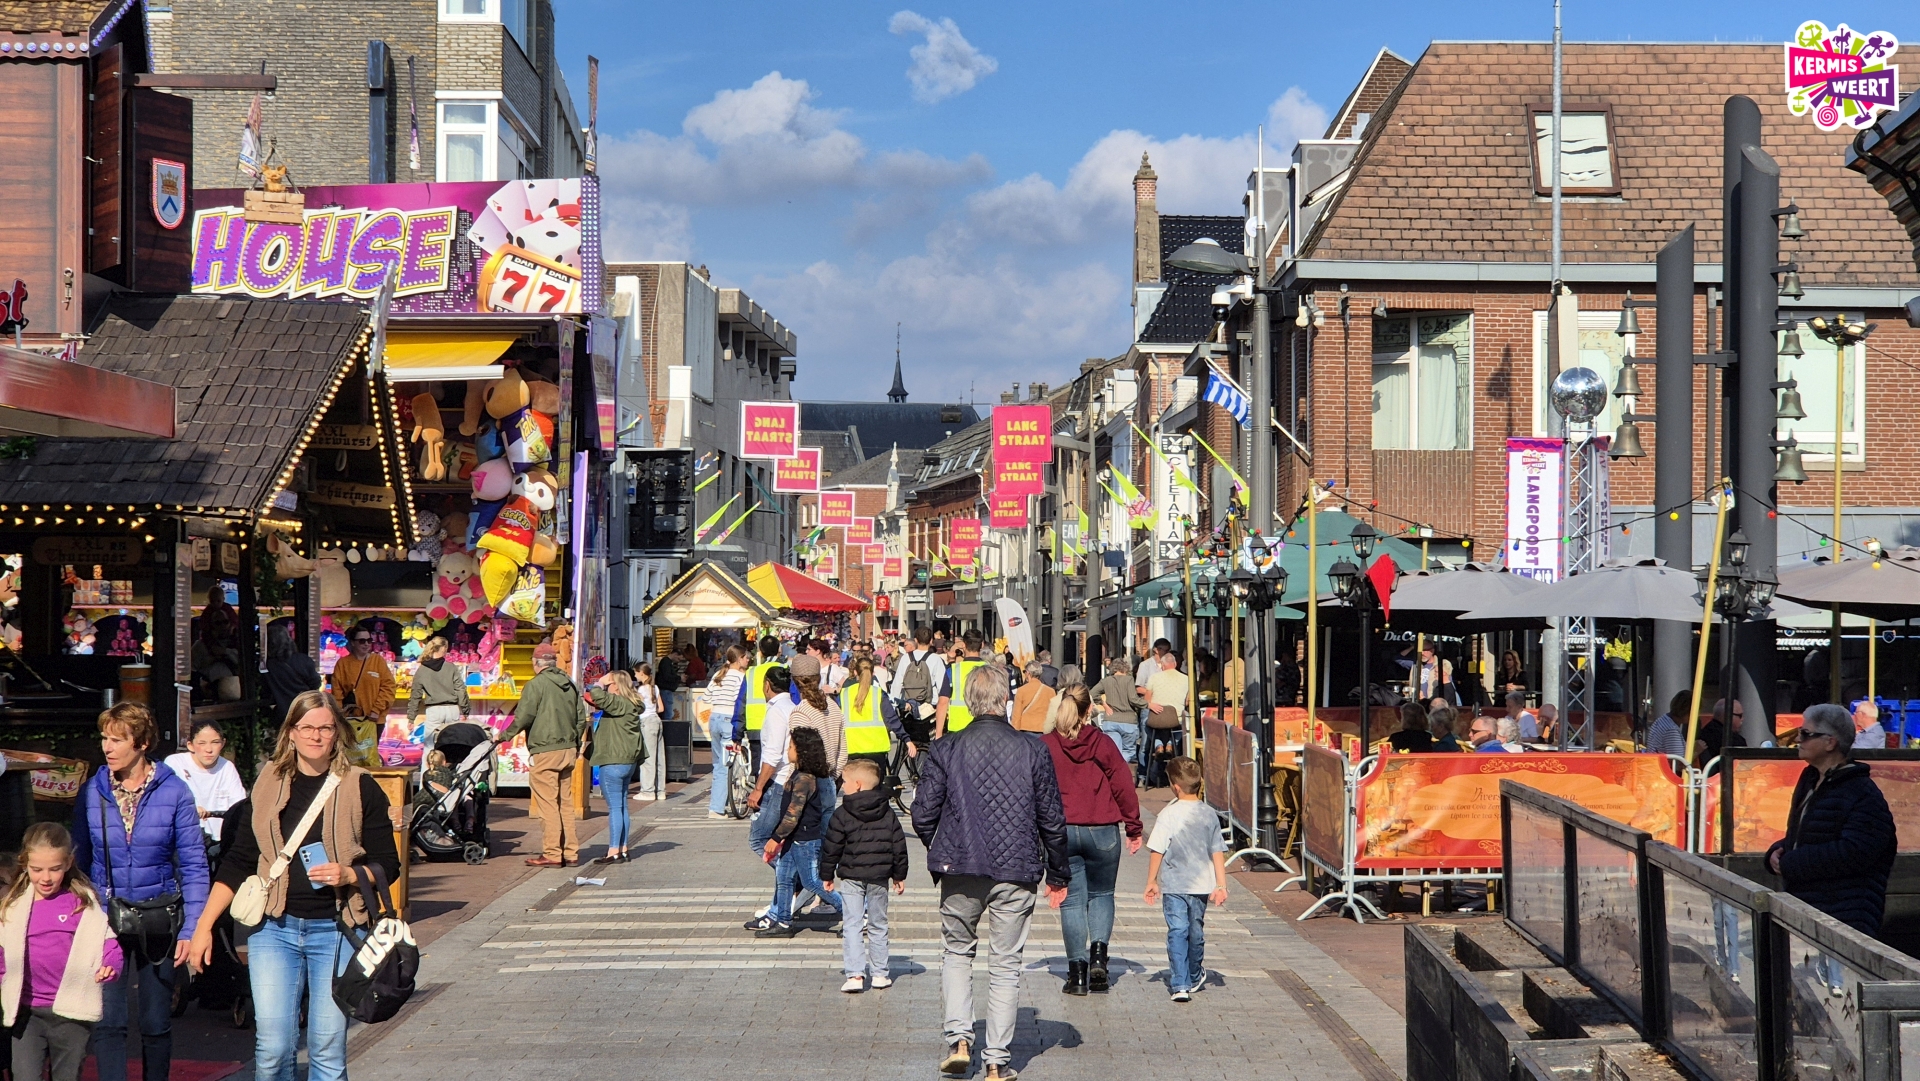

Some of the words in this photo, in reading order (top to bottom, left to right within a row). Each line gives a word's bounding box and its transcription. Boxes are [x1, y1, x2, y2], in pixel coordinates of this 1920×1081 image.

[192, 209, 455, 297] HOUSE
[502, 267, 530, 304] 7
[539, 282, 566, 312] 7
[1006, 421, 1038, 431] LANG
[999, 435, 1046, 446] STRAAT
[1005, 462, 1031, 470] LANG
[999, 473, 1039, 482] STRAAT
[317, 484, 383, 503] Thüringer
[993, 509, 1024, 517] STRAAT
[1525, 475, 1540, 566] LANGPOORT
